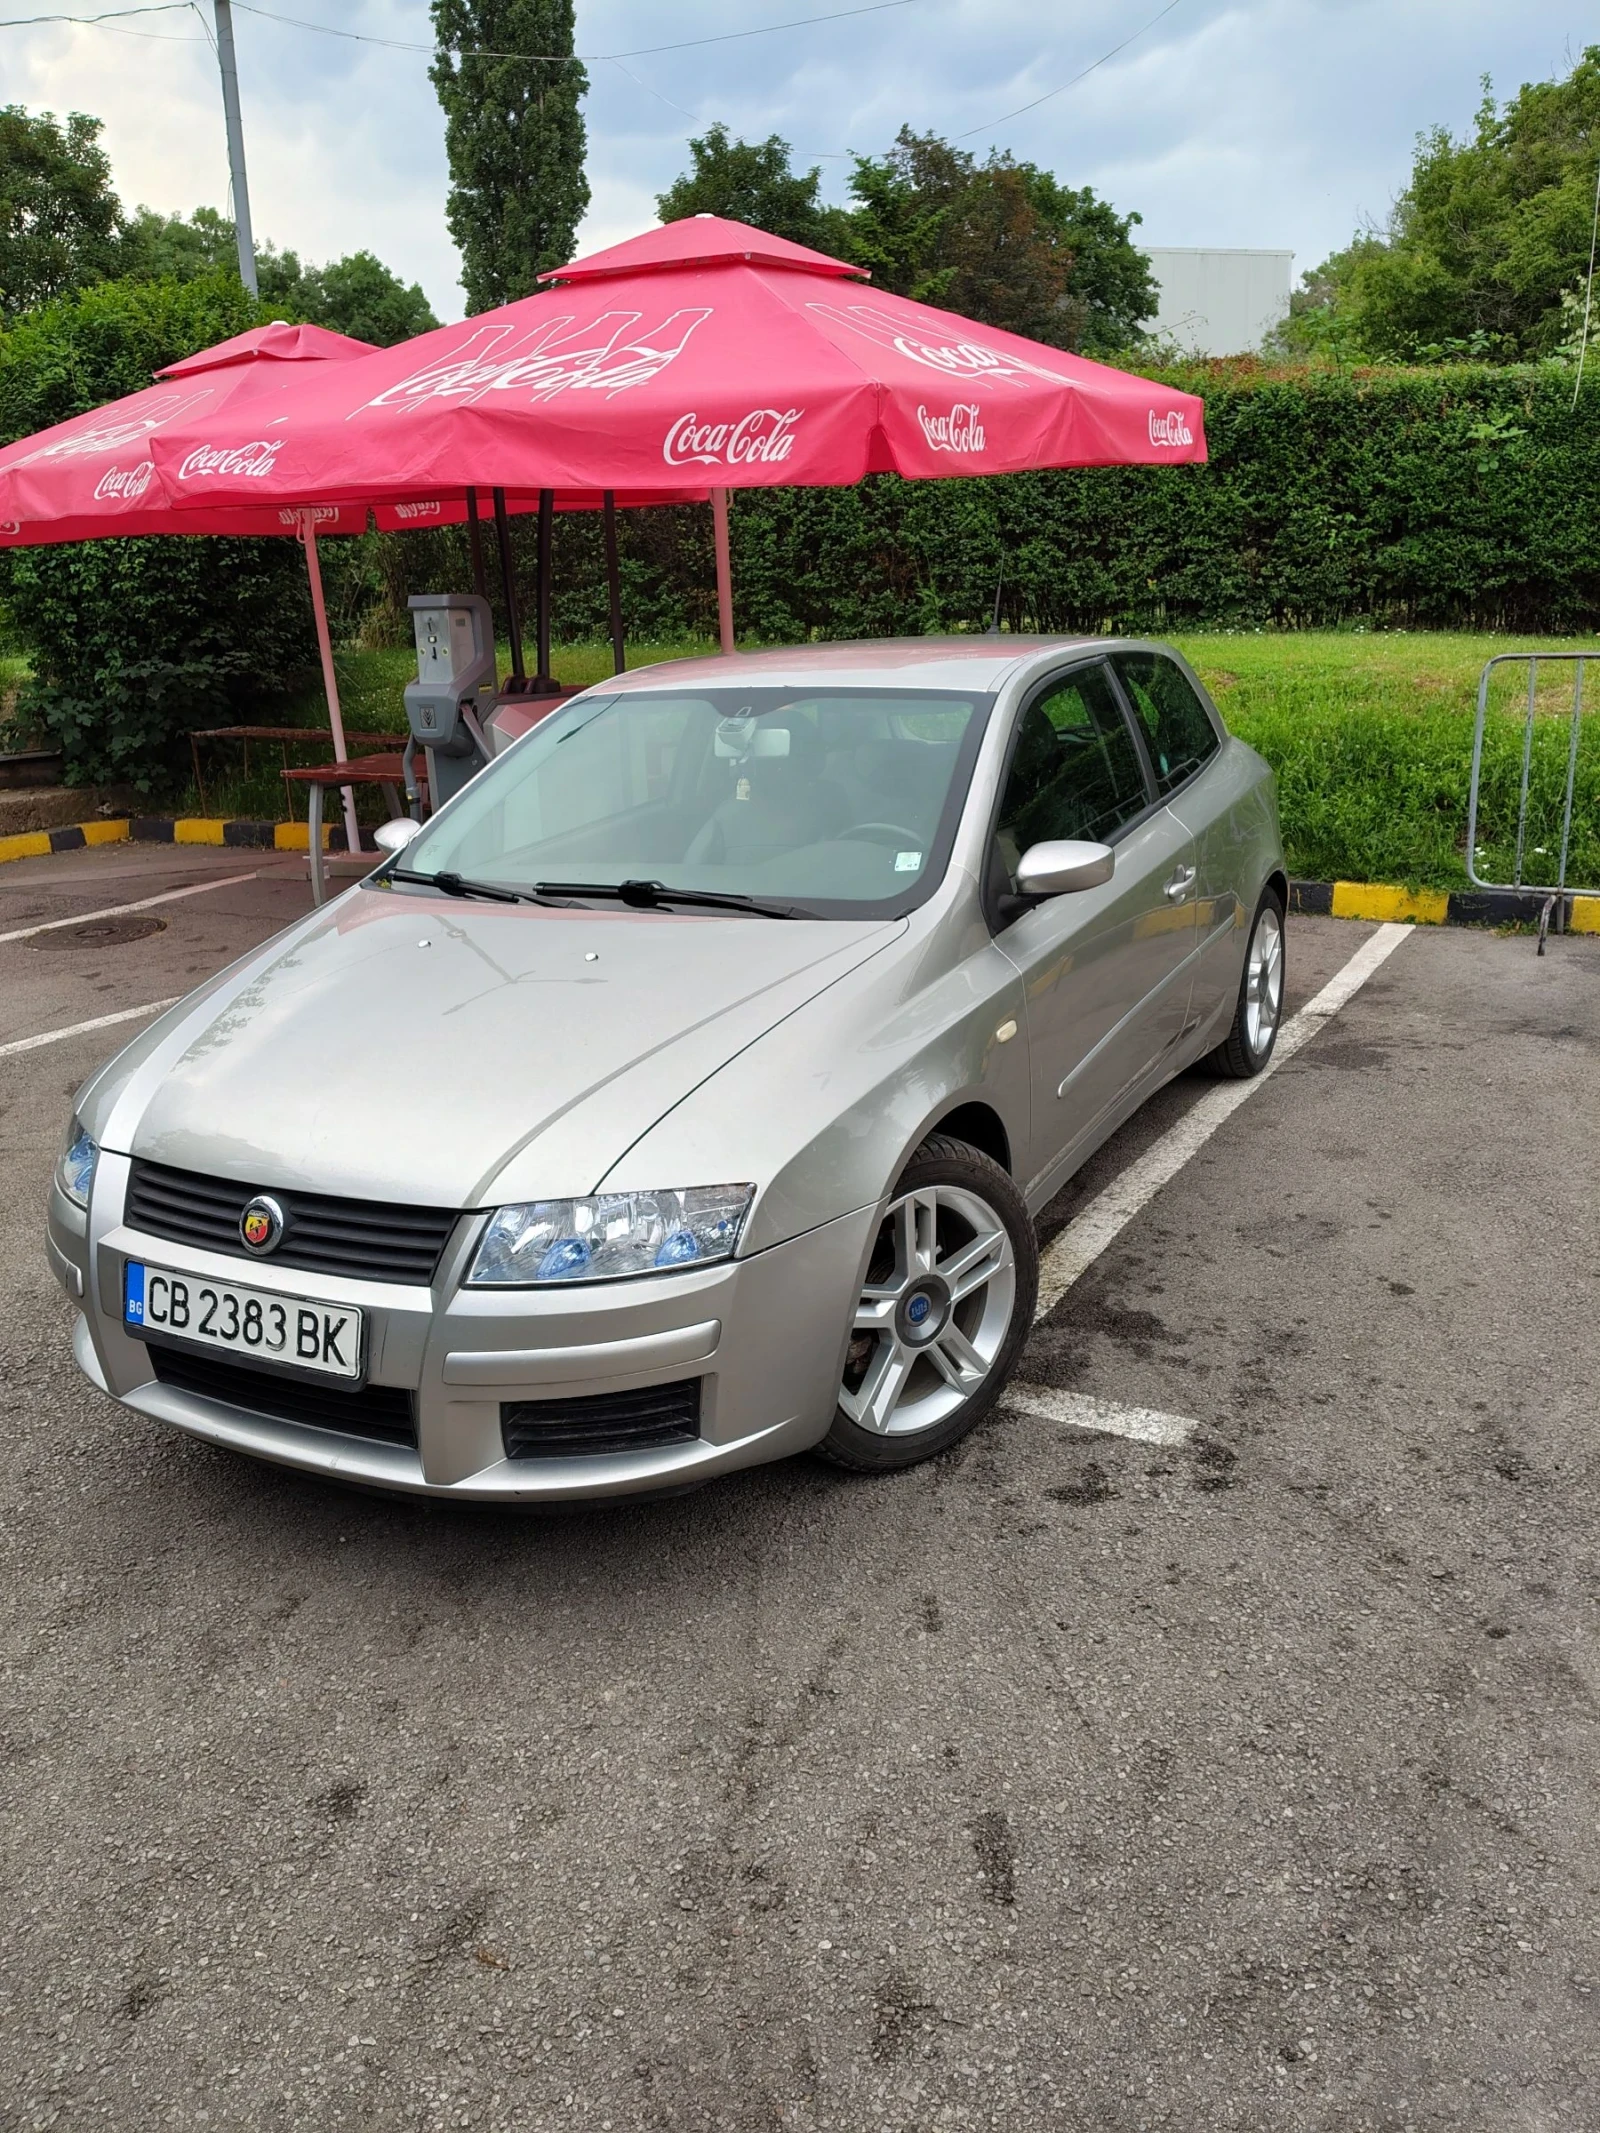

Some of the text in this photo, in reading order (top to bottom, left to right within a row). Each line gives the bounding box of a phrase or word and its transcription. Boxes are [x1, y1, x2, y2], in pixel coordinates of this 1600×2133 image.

[663, 408, 804, 465] Coca-Cola
[917, 404, 987, 453] Coca-Cola
[1148, 410, 1193, 447] Coca-Cola
[179, 440, 287, 479] Coca-Cola
[94, 461, 155, 500] Coca-Cola
[129, 1299, 143, 1315] BG
[148, 1276, 347, 1367] CB 2383 BK
[911, 1301, 928, 1318] FIAT
